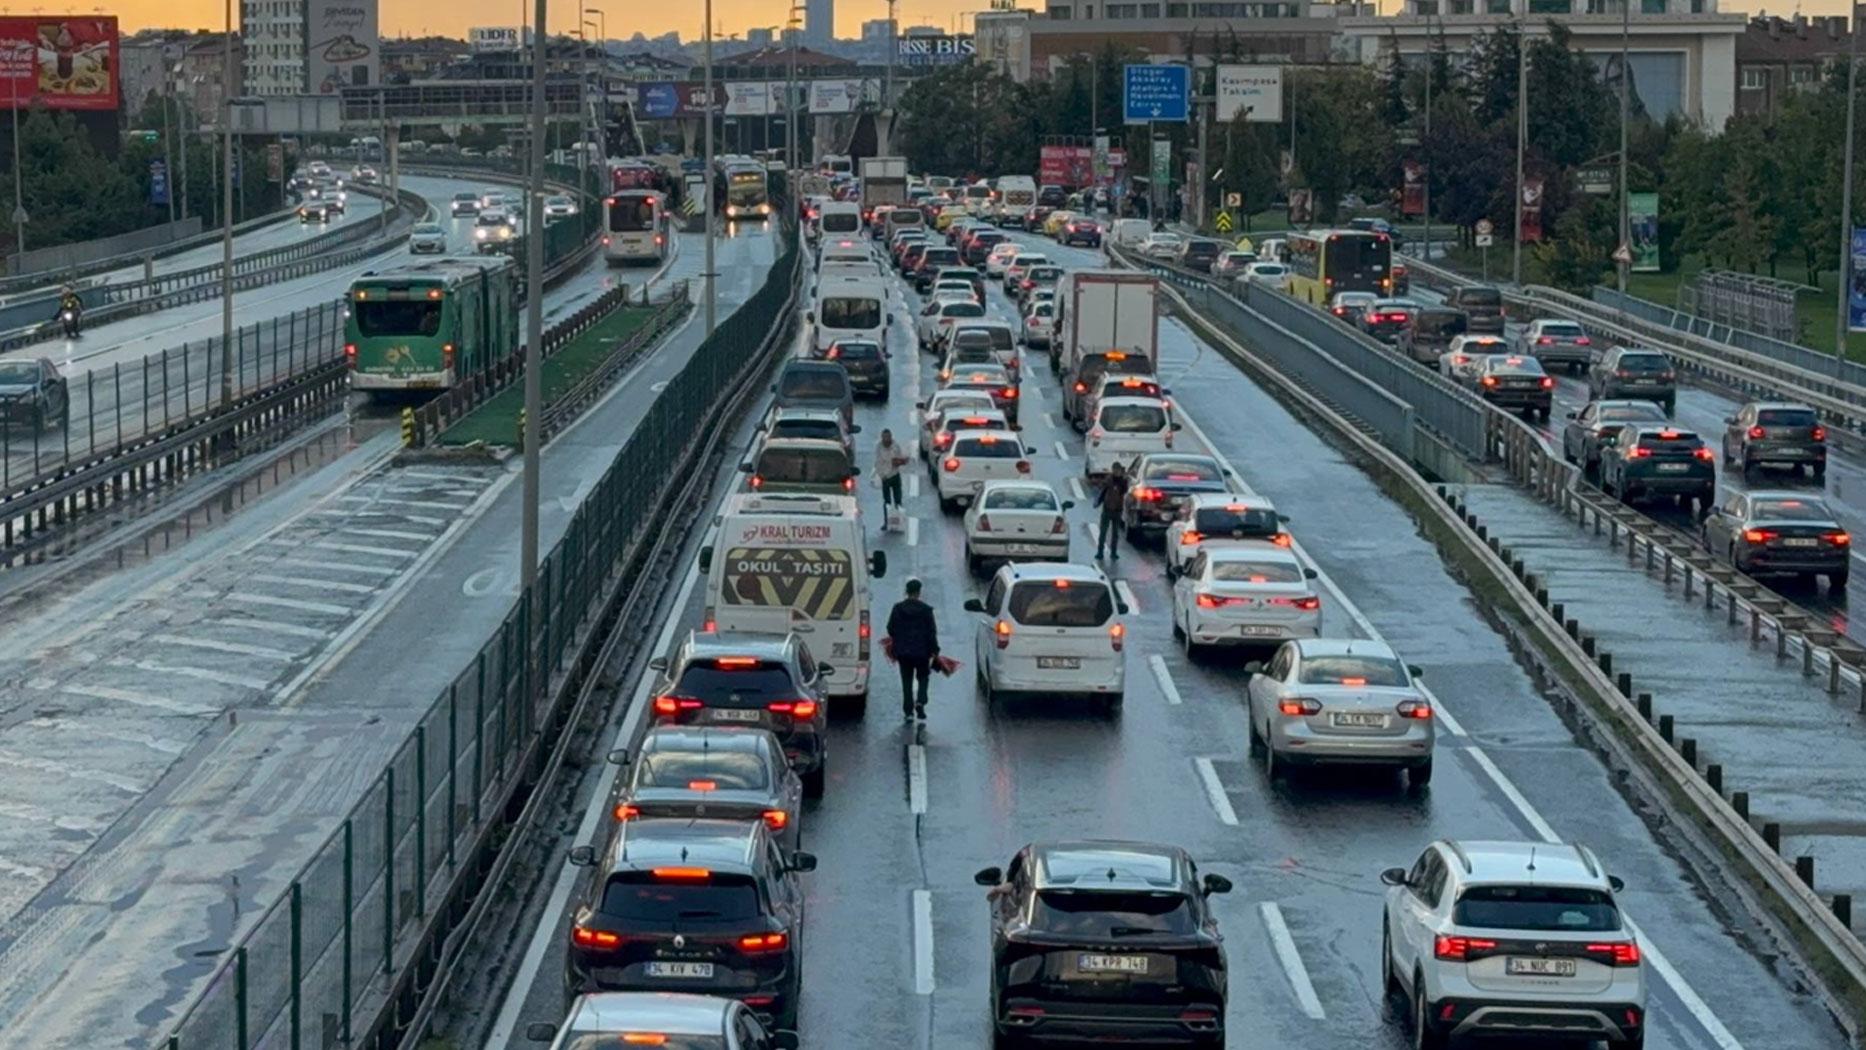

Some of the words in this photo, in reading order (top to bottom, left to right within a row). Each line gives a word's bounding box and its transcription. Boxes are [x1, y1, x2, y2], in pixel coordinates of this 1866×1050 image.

[1222, 87, 1262, 96] Taksim
[760, 525, 789, 538] KRAL
[737, 561, 782, 573] OKUL
[793, 561, 843, 575] TAŞITI
[651, 963, 663, 975] 34
[1514, 959, 1525, 971] 34
